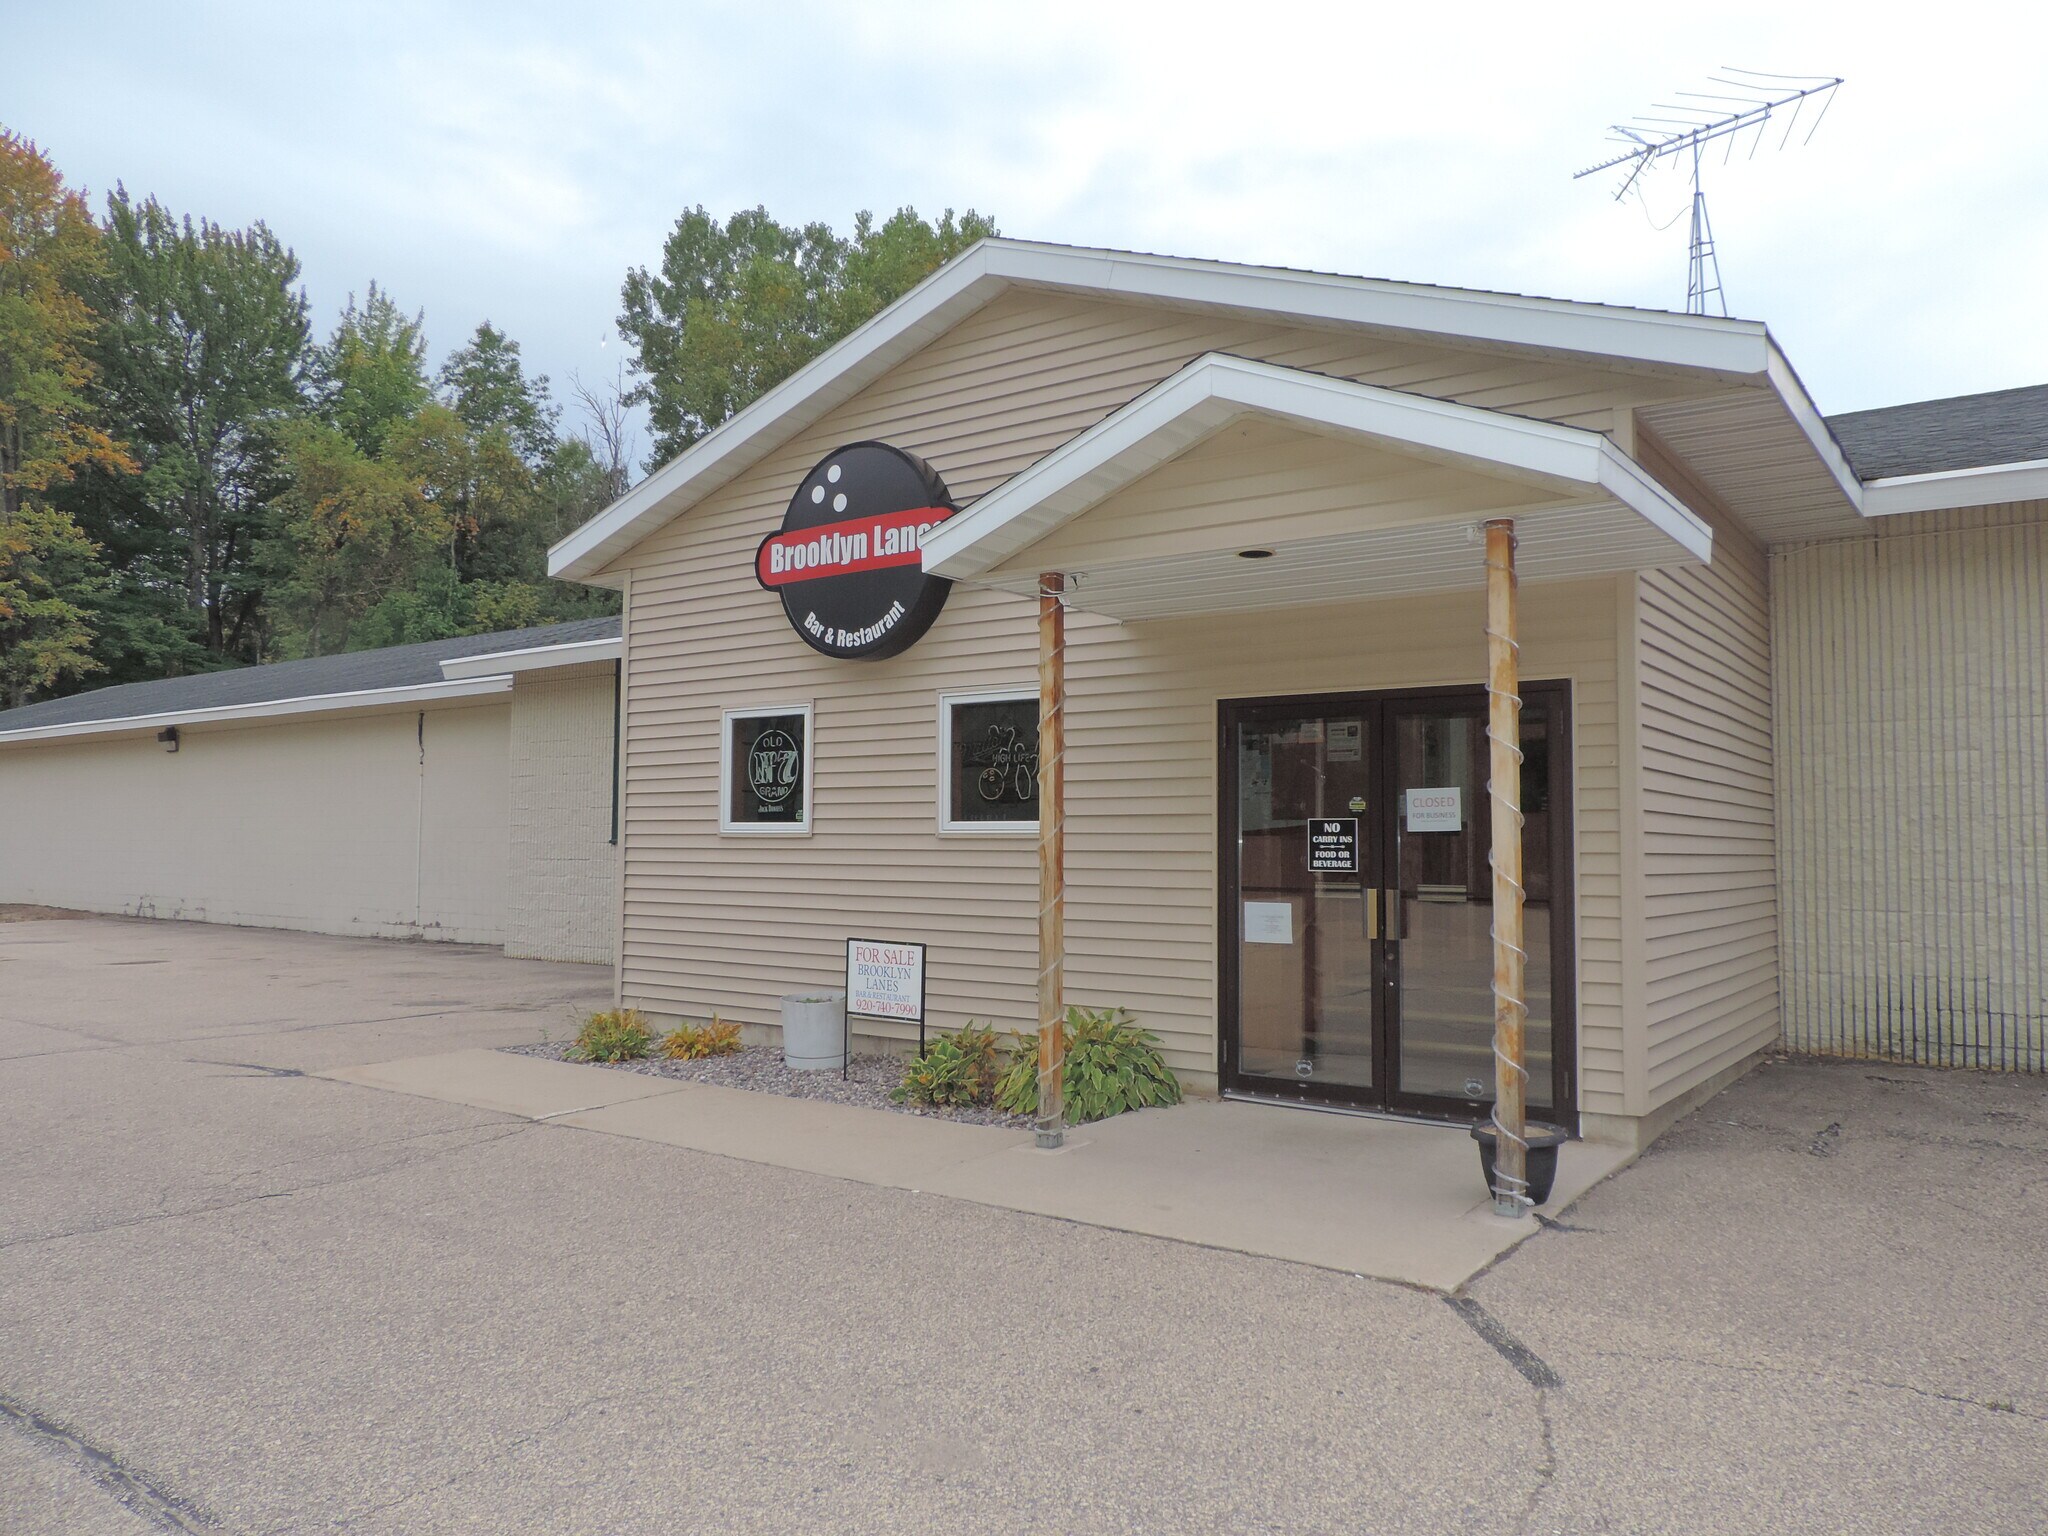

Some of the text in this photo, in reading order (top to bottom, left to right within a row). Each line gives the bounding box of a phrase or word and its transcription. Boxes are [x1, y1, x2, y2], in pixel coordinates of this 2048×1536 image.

[770, 520, 942, 574] Brooklyn Lane
[803, 600, 906, 648] Bar & Restaurant
[763, 736, 782, 748] OLD
[992, 753, 1011, 763] HIGH
[1412, 797, 1455, 808] CLOSED
[1426, 811, 1456, 819] BUSINESS
[1324, 822, 1341, 833] NO
[1312, 835, 1353, 843] CARRY INS
[1315, 850, 1350, 859] FOOD OR
[1312, 860, 1352, 868] BEVERAGE
[856, 946, 915, 966] FOR SALE
[858, 963, 911, 980] BROOKLYN
[866, 978, 899, 992] LANES
[855, 990, 910, 1003] BAR & RESTAURANT
[856, 998, 918, 1016] 920-740-7990
